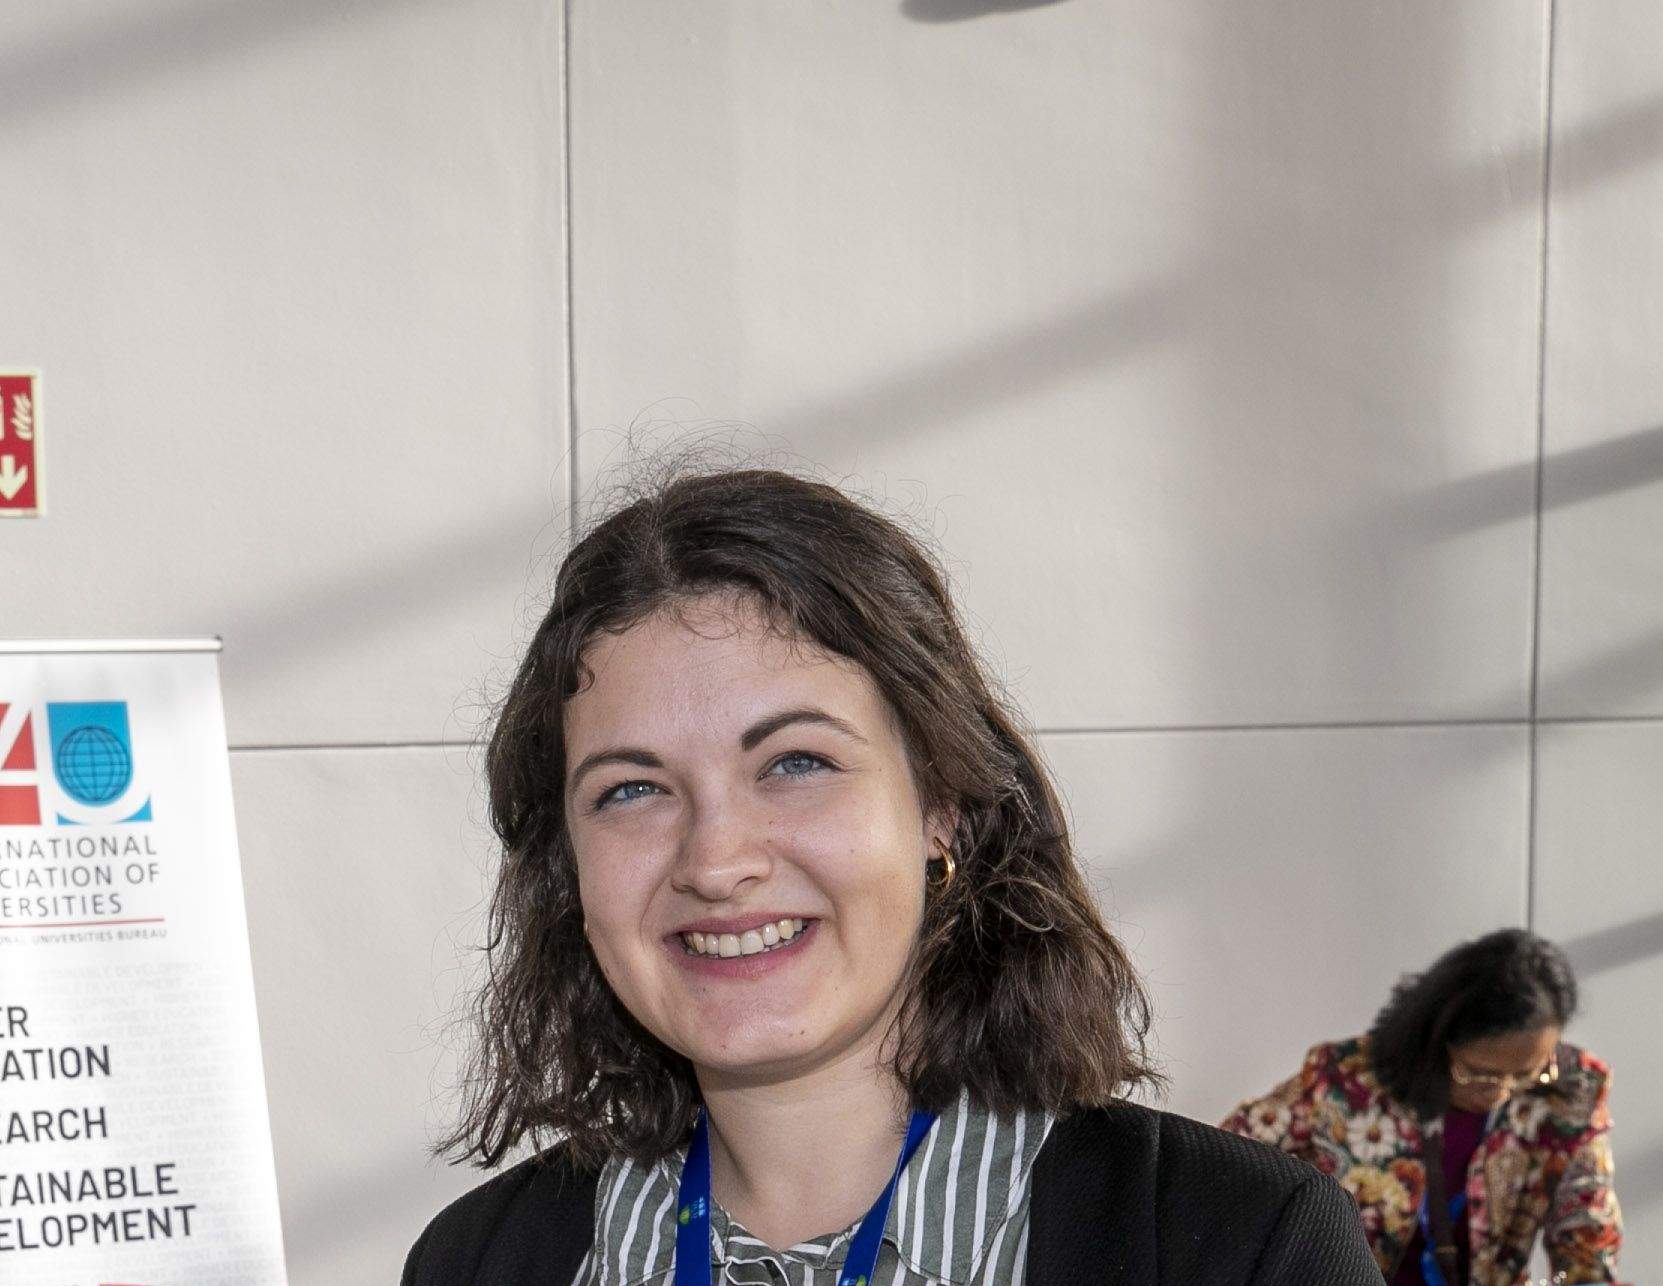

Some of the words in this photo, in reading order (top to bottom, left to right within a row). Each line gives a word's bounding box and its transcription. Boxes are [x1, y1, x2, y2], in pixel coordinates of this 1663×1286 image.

[124, 862, 161, 885] OF
[32, 931, 114, 947] UNIVERSITIES
[116, 928, 168, 941] BUREAU
